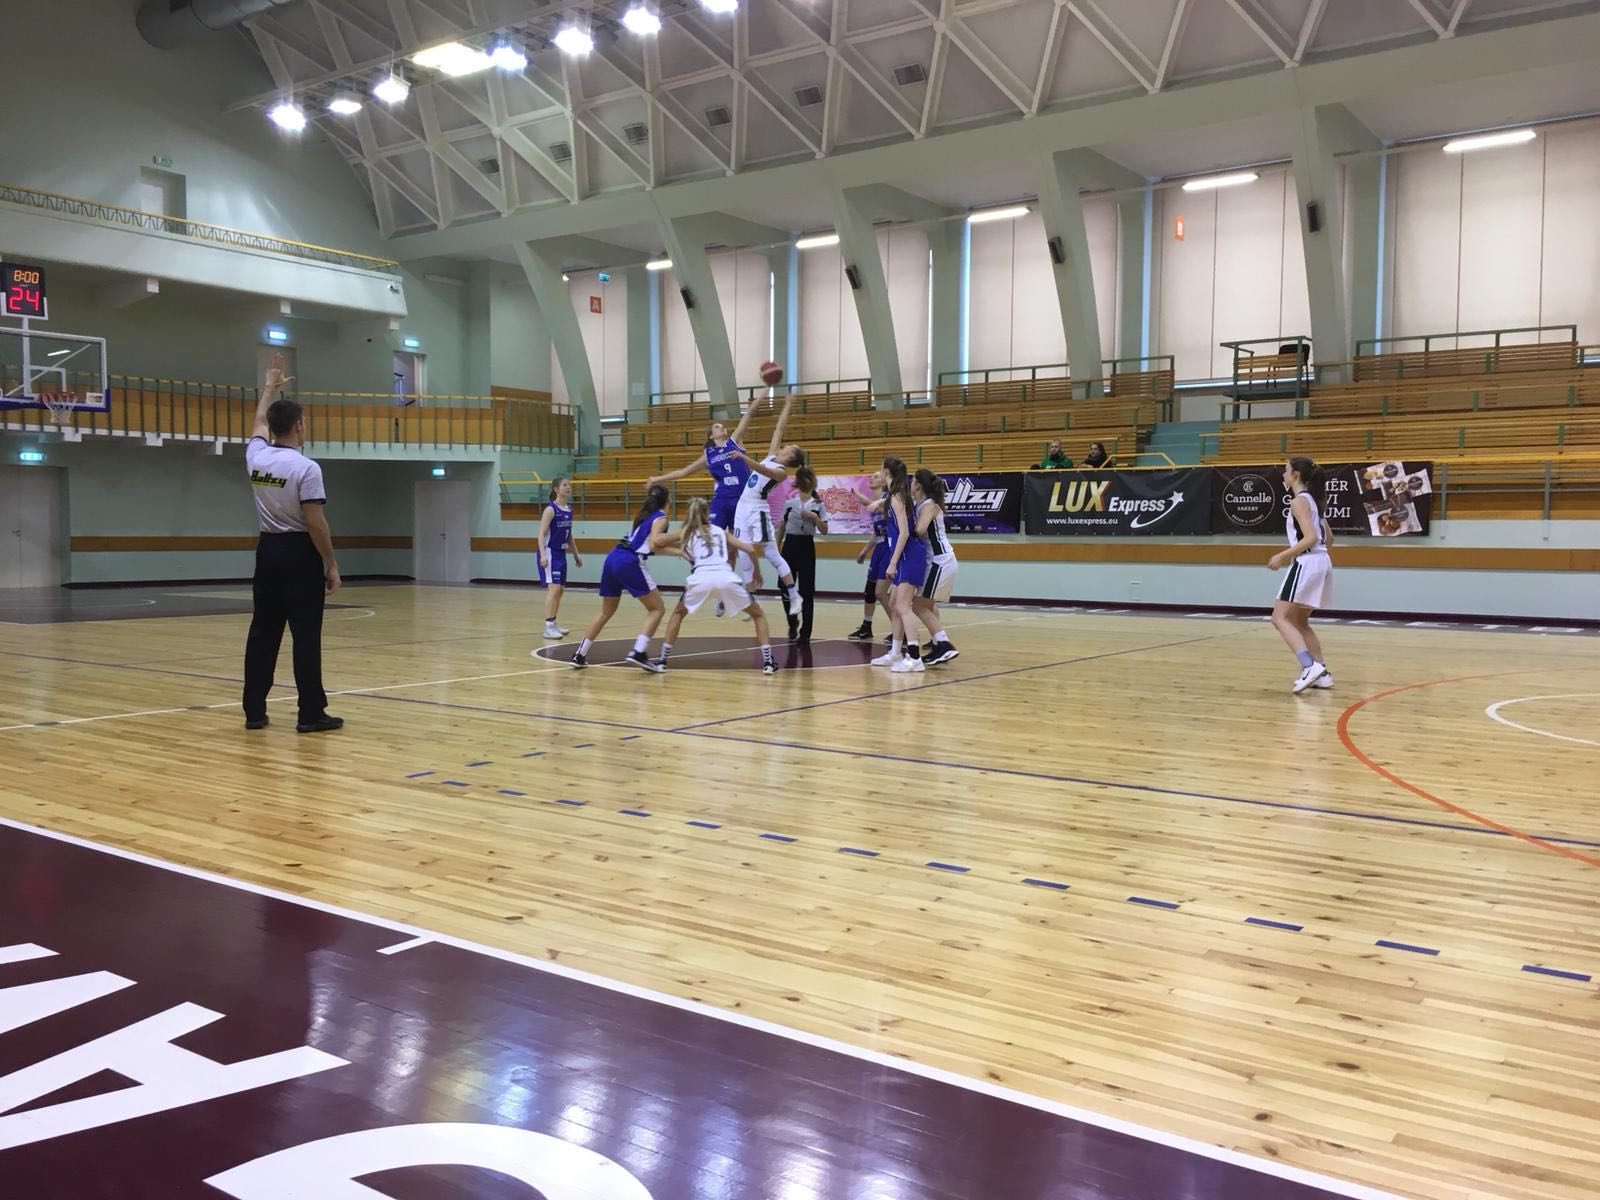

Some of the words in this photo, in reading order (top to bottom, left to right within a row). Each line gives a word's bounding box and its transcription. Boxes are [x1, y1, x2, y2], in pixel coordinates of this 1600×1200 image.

[14, 269, 39, 284] 8:00
[8, 287, 40, 312] 24
[724, 463, 732, 473] 9
[944, 481, 1005, 509] allzy
[1048, 480, 1112, 512] LUX
[1108, 497, 1165, 515] Express
[1225, 492, 1272, 503] Cannelle
[1046, 517, 1118, 525] www.luxexpress.eu
